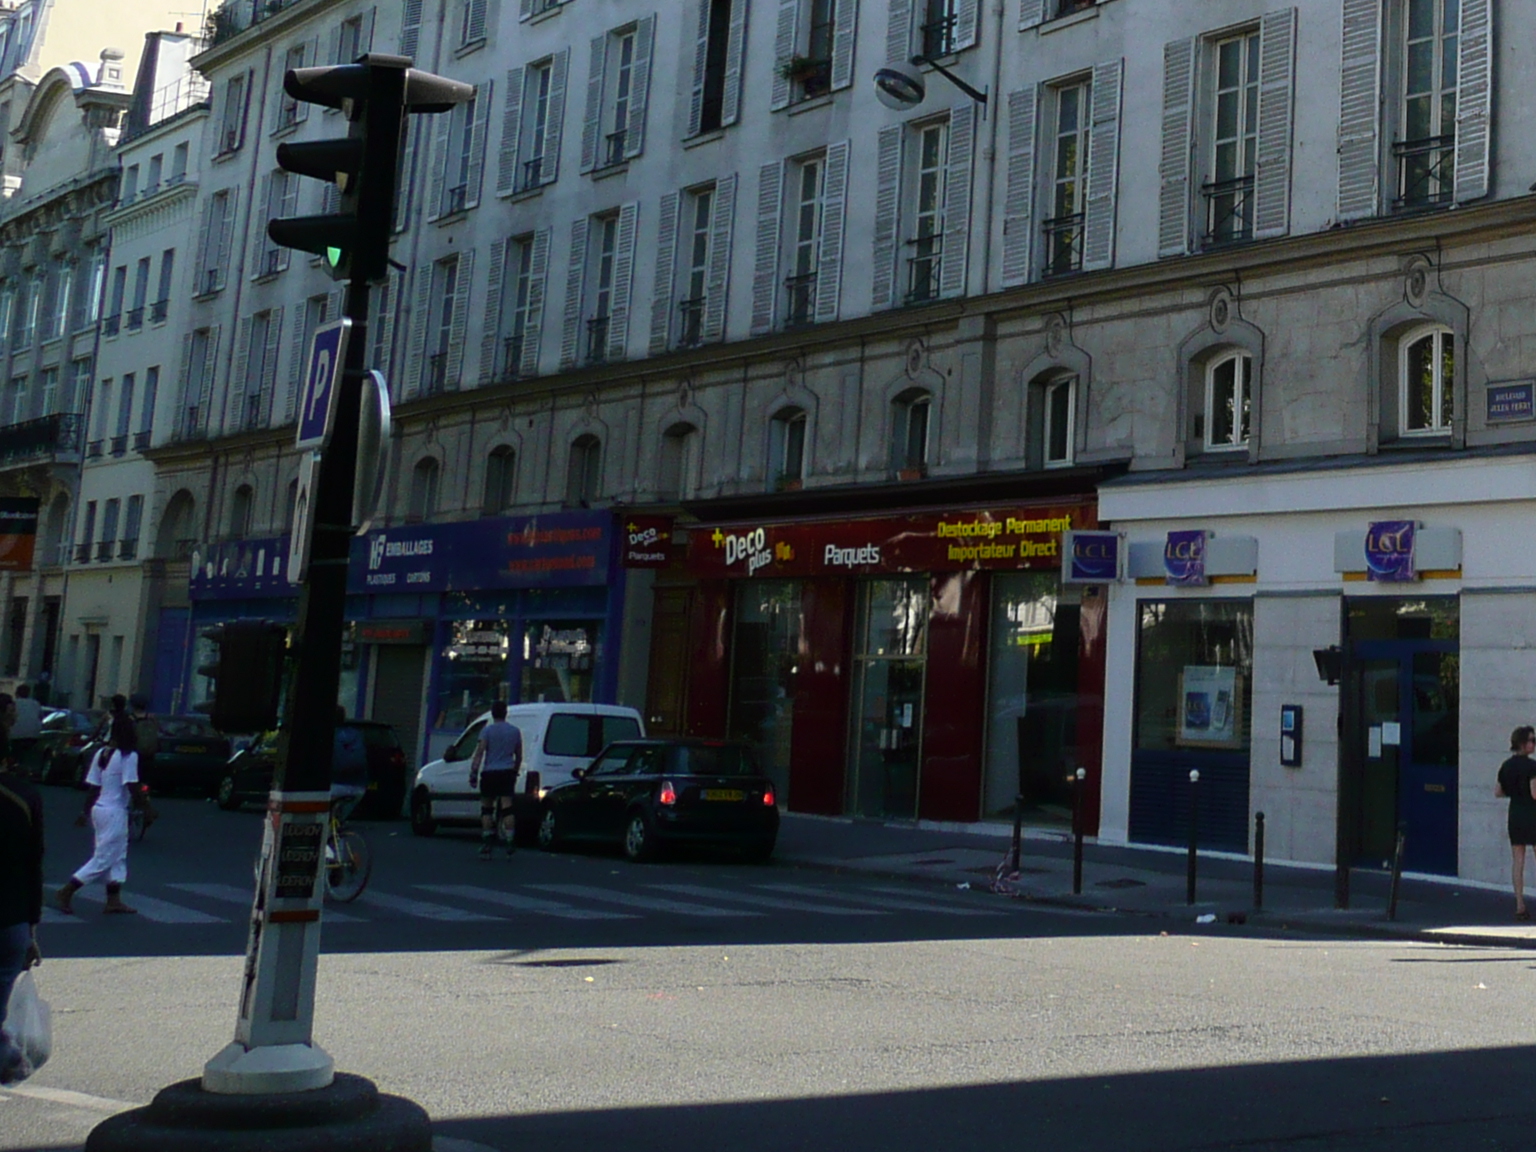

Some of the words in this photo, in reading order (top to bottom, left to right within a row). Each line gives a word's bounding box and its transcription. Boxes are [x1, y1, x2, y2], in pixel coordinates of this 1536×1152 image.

[309, 349, 330, 421] P
[628, 528, 657, 545] Deco
[937, 520, 1003, 539] Destockage
[1005, 514, 1072, 535] Permanent
[725, 528, 765, 566] Deco
[948, 542, 1016, 563] Importateur
[1019, 539, 1058, 557] Direct
[1075, 544, 1113, 559] LCL
[1166, 542, 1201, 560] LCL
[1368, 532, 1408, 553] LCL
[628, 552, 666, 562] Parquets
[749, 548, 773, 577] plus
[823, 542, 880, 569] Parquets
